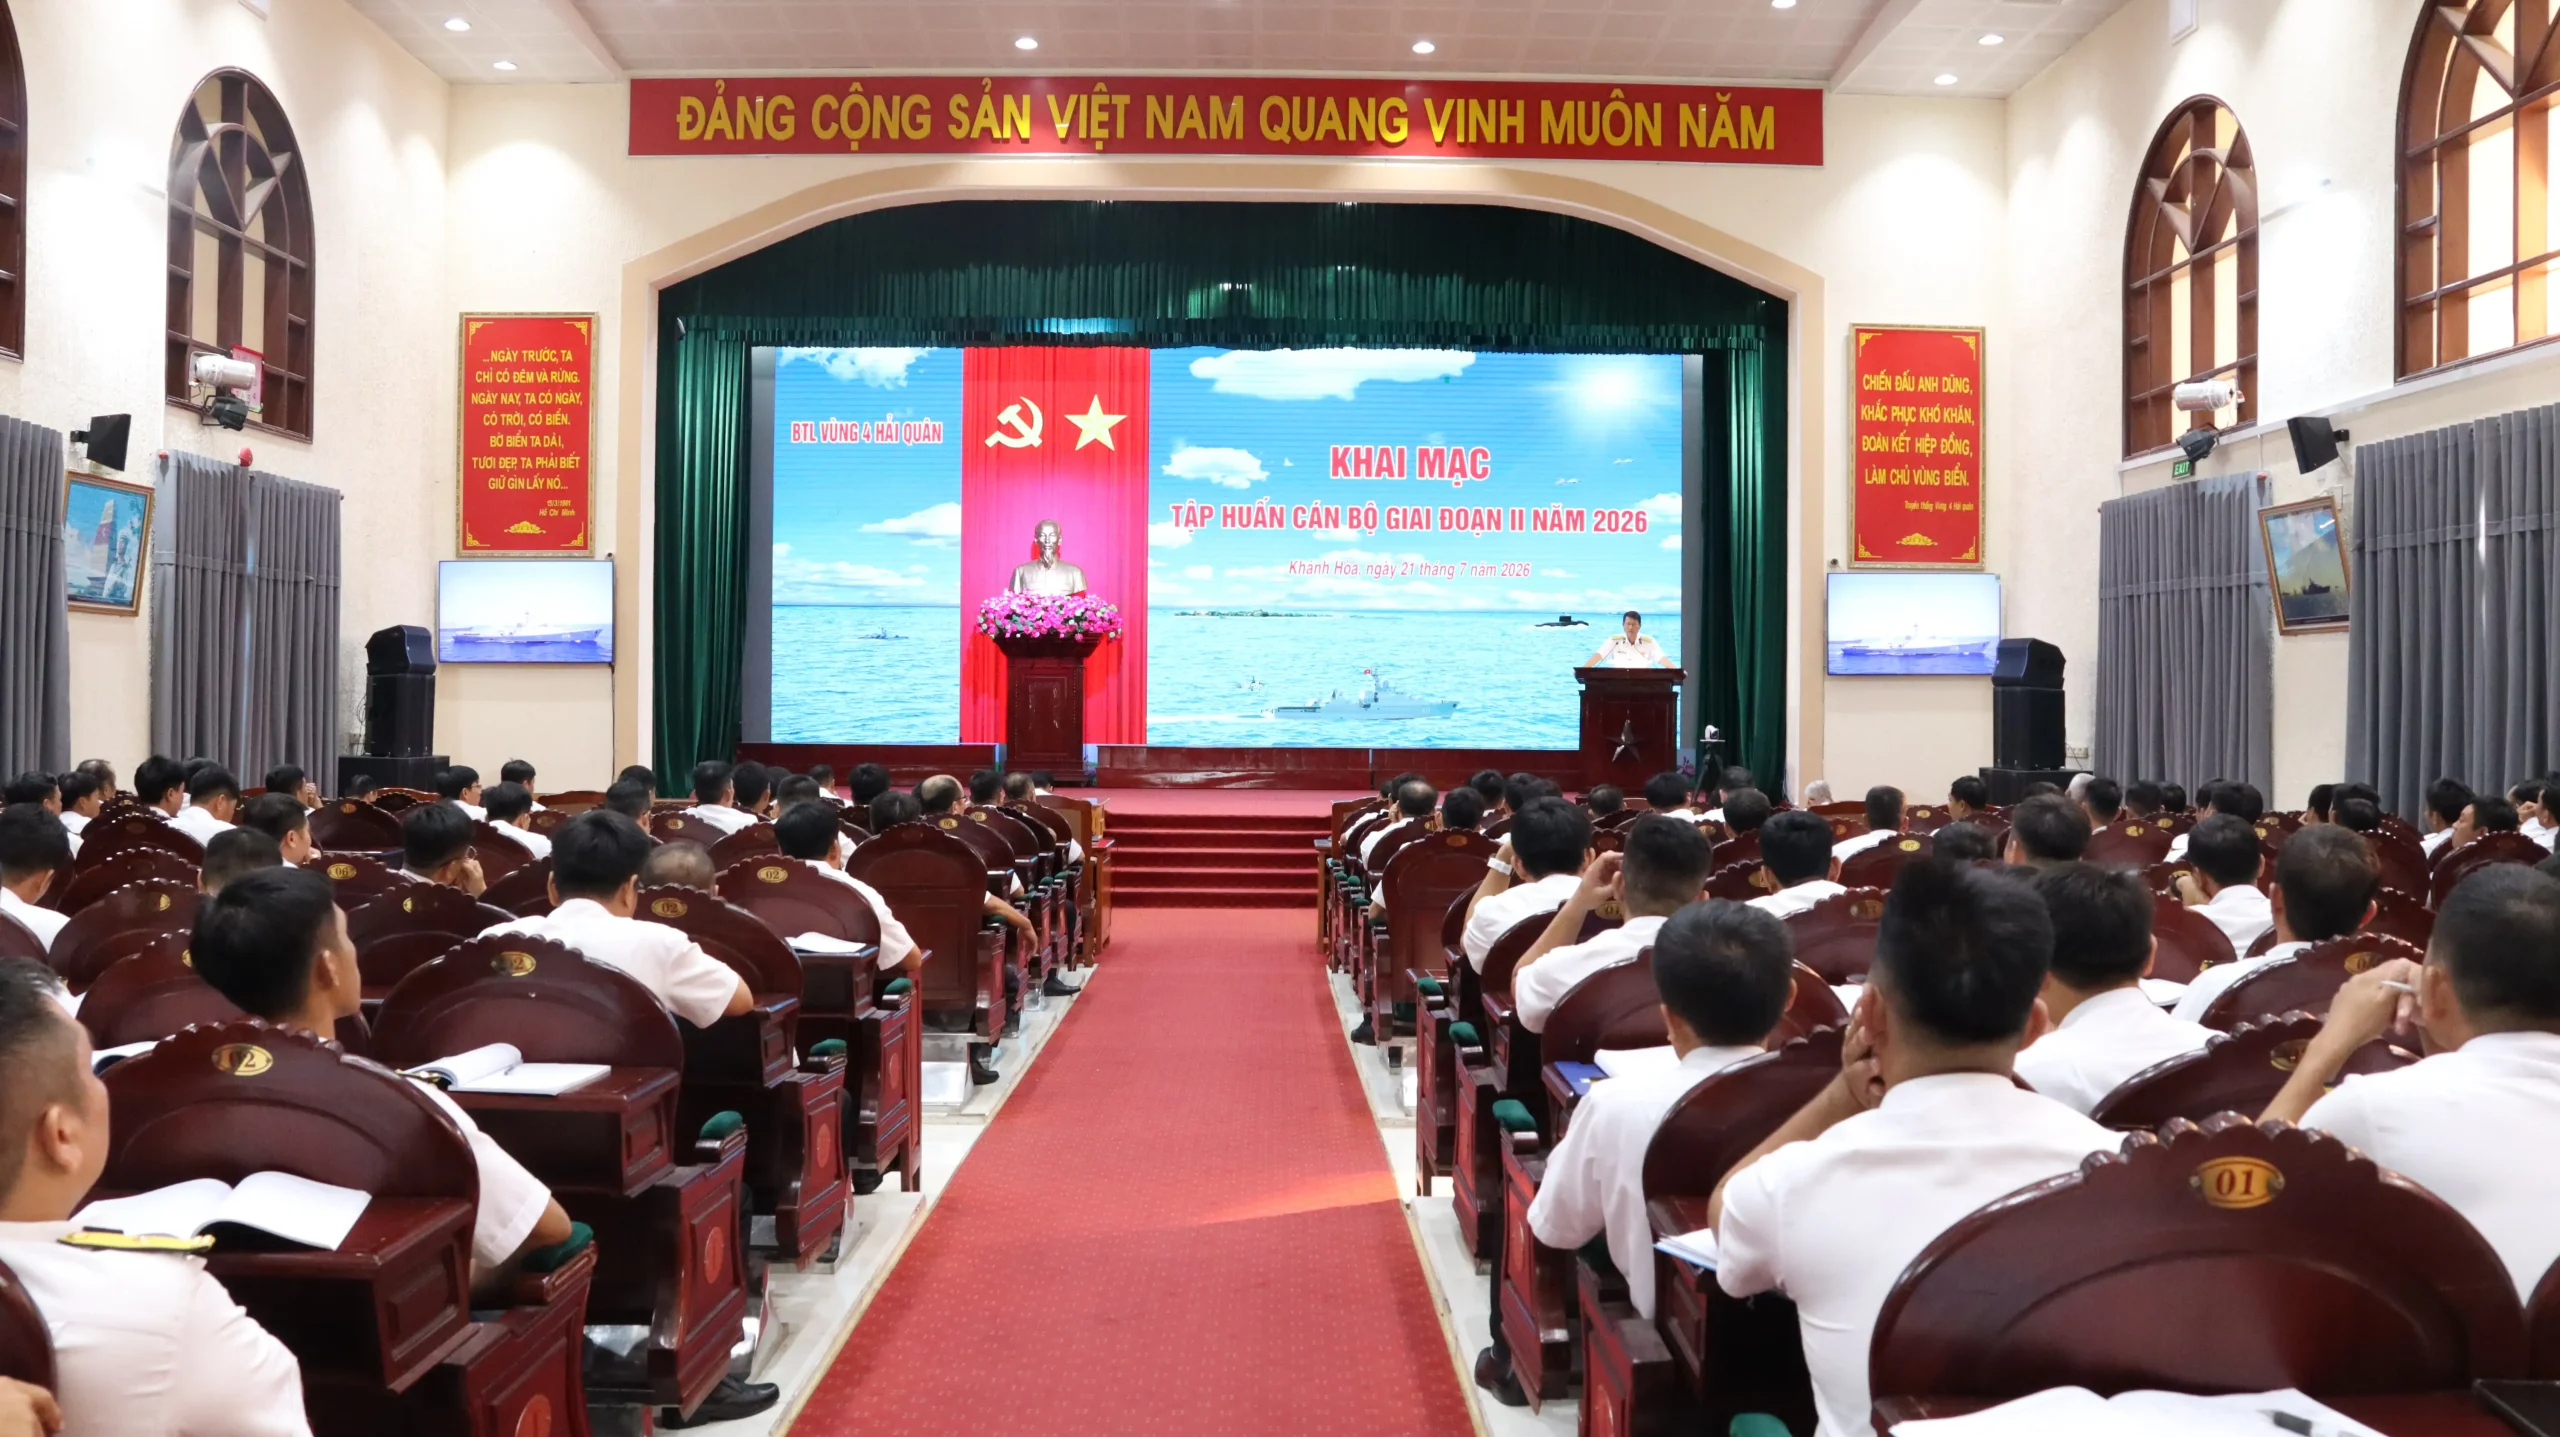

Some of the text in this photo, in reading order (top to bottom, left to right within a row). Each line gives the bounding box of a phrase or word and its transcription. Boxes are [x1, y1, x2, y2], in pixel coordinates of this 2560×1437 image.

[676, 78, 1775, 151] ĐẢNG CỘNG SẢN VIỆT NAM QUANG VINH MUÔN NĂM
[522, 346, 558, 364] TRƯỚC,
[560, 350, 573, 362] TA
[475, 366, 580, 383] CHỈ CÓ ĐÊM VÀ RỪNG.
[1863, 369, 1973, 395] CHIẾN ĐẤU ANH DŨNG,
[471, 389, 583, 406] NGÀY NAY, TA CÓ NGÀY,
[528, 410, 542, 426] CÓ
[546, 407, 571, 426] BIỂN.
[1861, 399, 1975, 427] KHẮC PHỤC KHÓ KHĂN,
[489, 432, 504, 447] BỜ
[506, 430, 527, 447] BIỂN
[530, 435, 541, 447] TA
[792, 413, 943, 446] BTL VÙNG 4 HẢI QUÂN
[1862, 429, 1973, 458] ĐOÀN KẾT HIỆP ĐỒNG,
[472, 455, 496, 469] TƯƠI
[520, 457, 533, 469] TA
[535, 452, 558, 469] PHẢI
[559, 451, 580, 469] BIẾT
[1331, 446, 1490, 487] KHAI MẠC
[2174, 461, 2190, 475] EXIT
[488, 474, 506, 489] GIỮ
[507, 474, 524, 489] GÌN
[526, 472, 544, 489] LẤY
[1865, 462, 1970, 486] LÀM CHỦ VÙNG BIỂN.
[1171, 497, 1648, 537] TẬP HUẤN CÁN BỘ GIAI ĐOẠN II NĂM 2026
[1289, 560, 1329, 576] Khánh
[1366, 560, 1397, 579] ngày
[1400, 562, 1414, 576] 21
[1419, 561, 1455, 580] tháng
[1460, 562, 1467, 577] 7
[1470, 562, 1497, 577] năm
[1500, 563, 1530, 577] 2026
[335, 865, 349, 876] 06
[765, 870, 780, 880] 02
[661, 901, 679, 912] 02
[2216, 1171, 2256, 1196] 01
